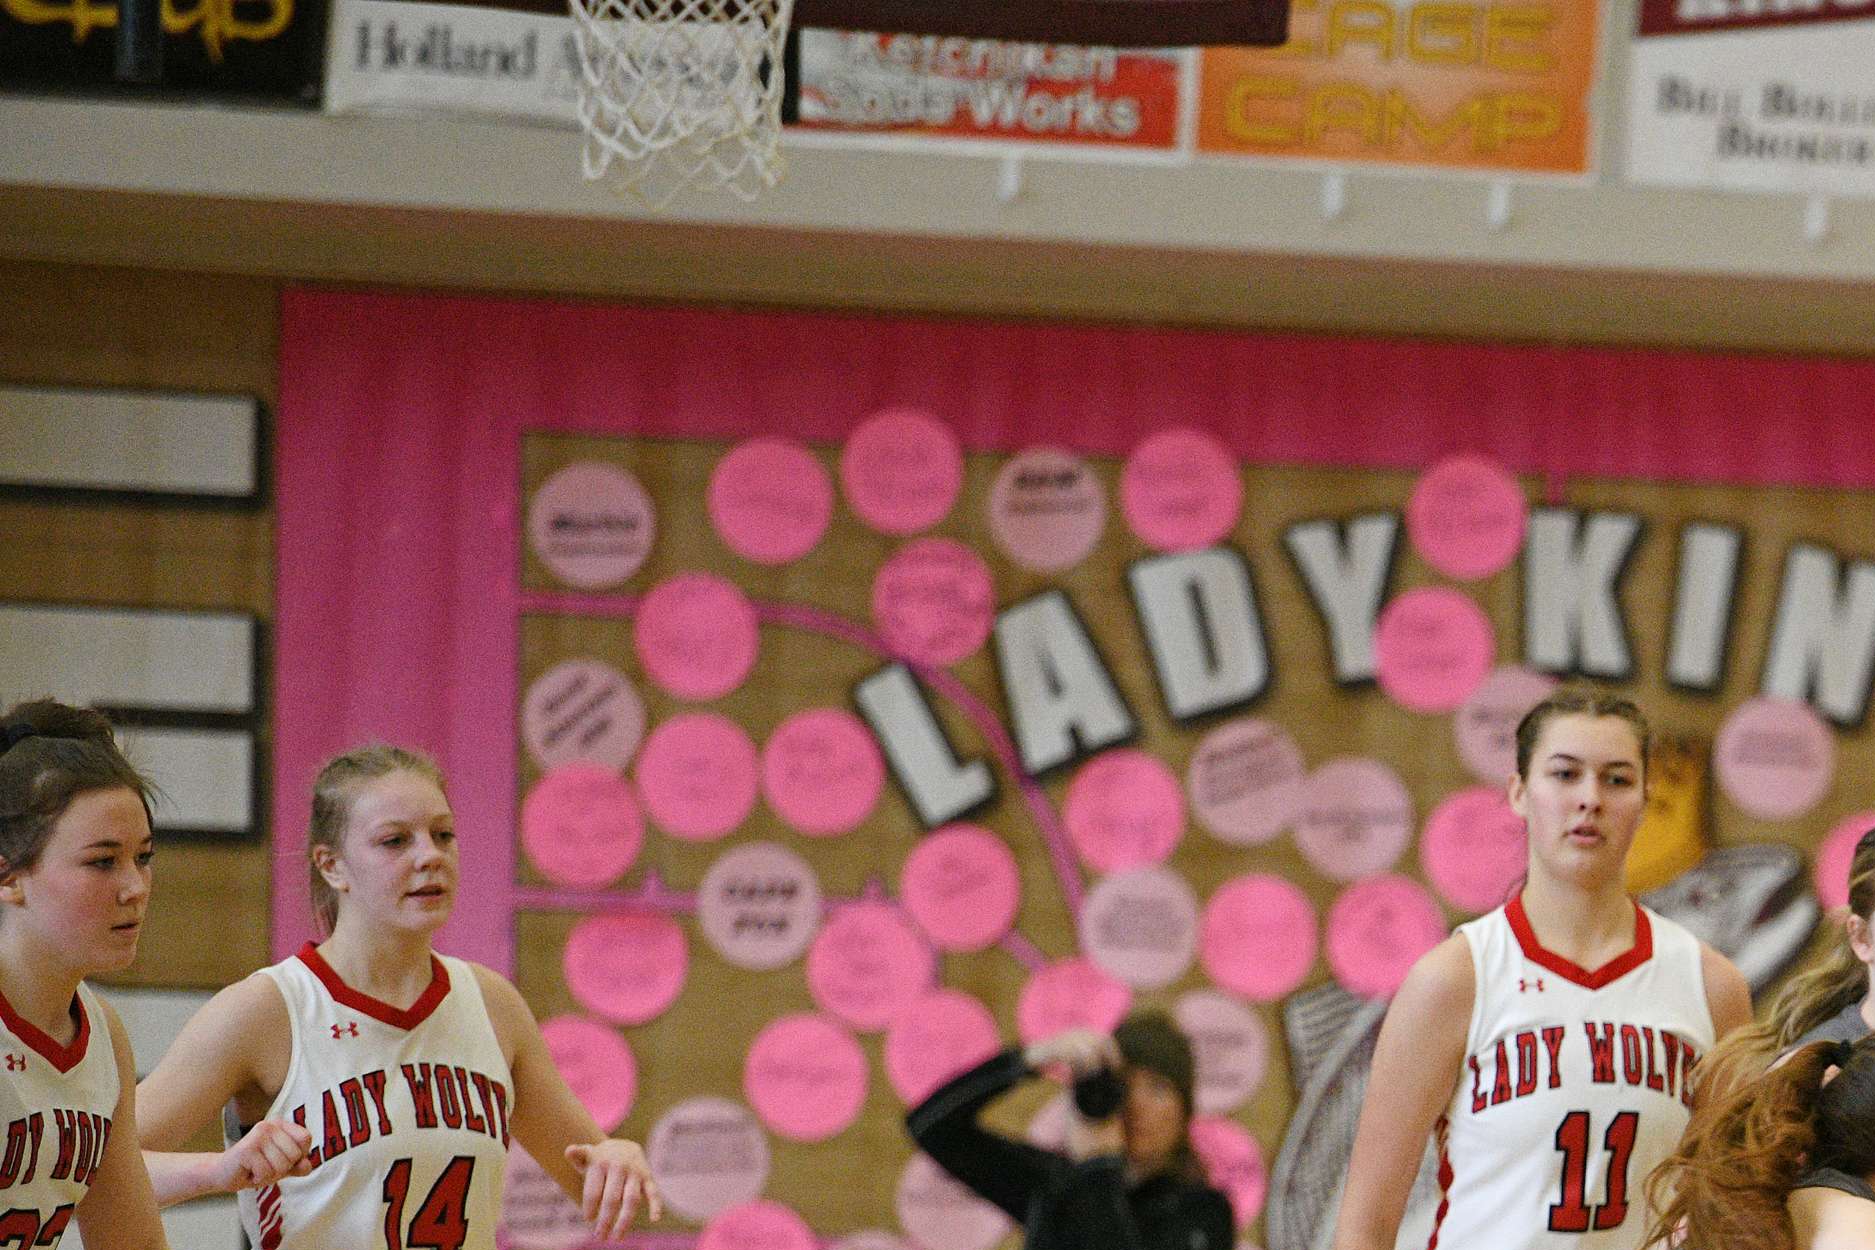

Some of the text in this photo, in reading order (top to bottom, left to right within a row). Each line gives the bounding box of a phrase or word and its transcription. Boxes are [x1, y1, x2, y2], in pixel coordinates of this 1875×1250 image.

[355, 20, 538, 79] Holland
[966, 81, 1141, 135] Works
[1225, 77, 1564, 153] CAMP
[848, 508, 1402, 832] LADY
[1468, 1026, 1565, 1114] LADY
[0, 1111, 45, 1190] DY
[1547, 1111, 1640, 1233] 11
